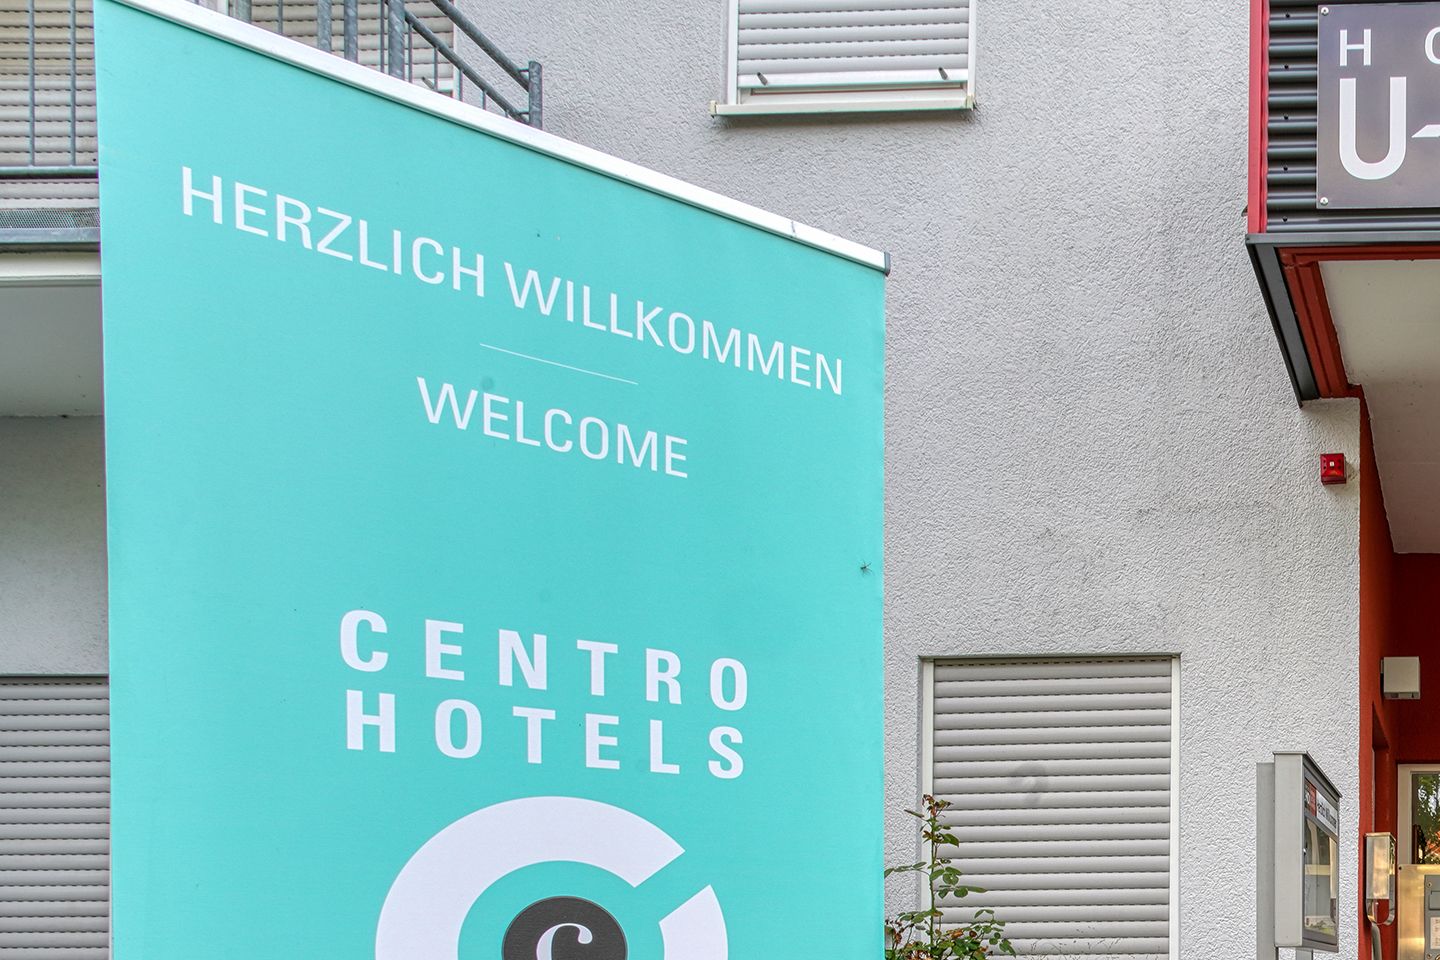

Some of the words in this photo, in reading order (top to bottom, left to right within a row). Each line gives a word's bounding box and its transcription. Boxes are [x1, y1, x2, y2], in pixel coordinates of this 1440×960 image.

[181, 165, 485, 298] HERZLICH
[503, 261, 843, 396] WILLKOMMEN
[416, 376, 688, 479] WELCOME
[339, 609, 748, 711] CENTRO
[346, 689, 744, 779] HOTELS
